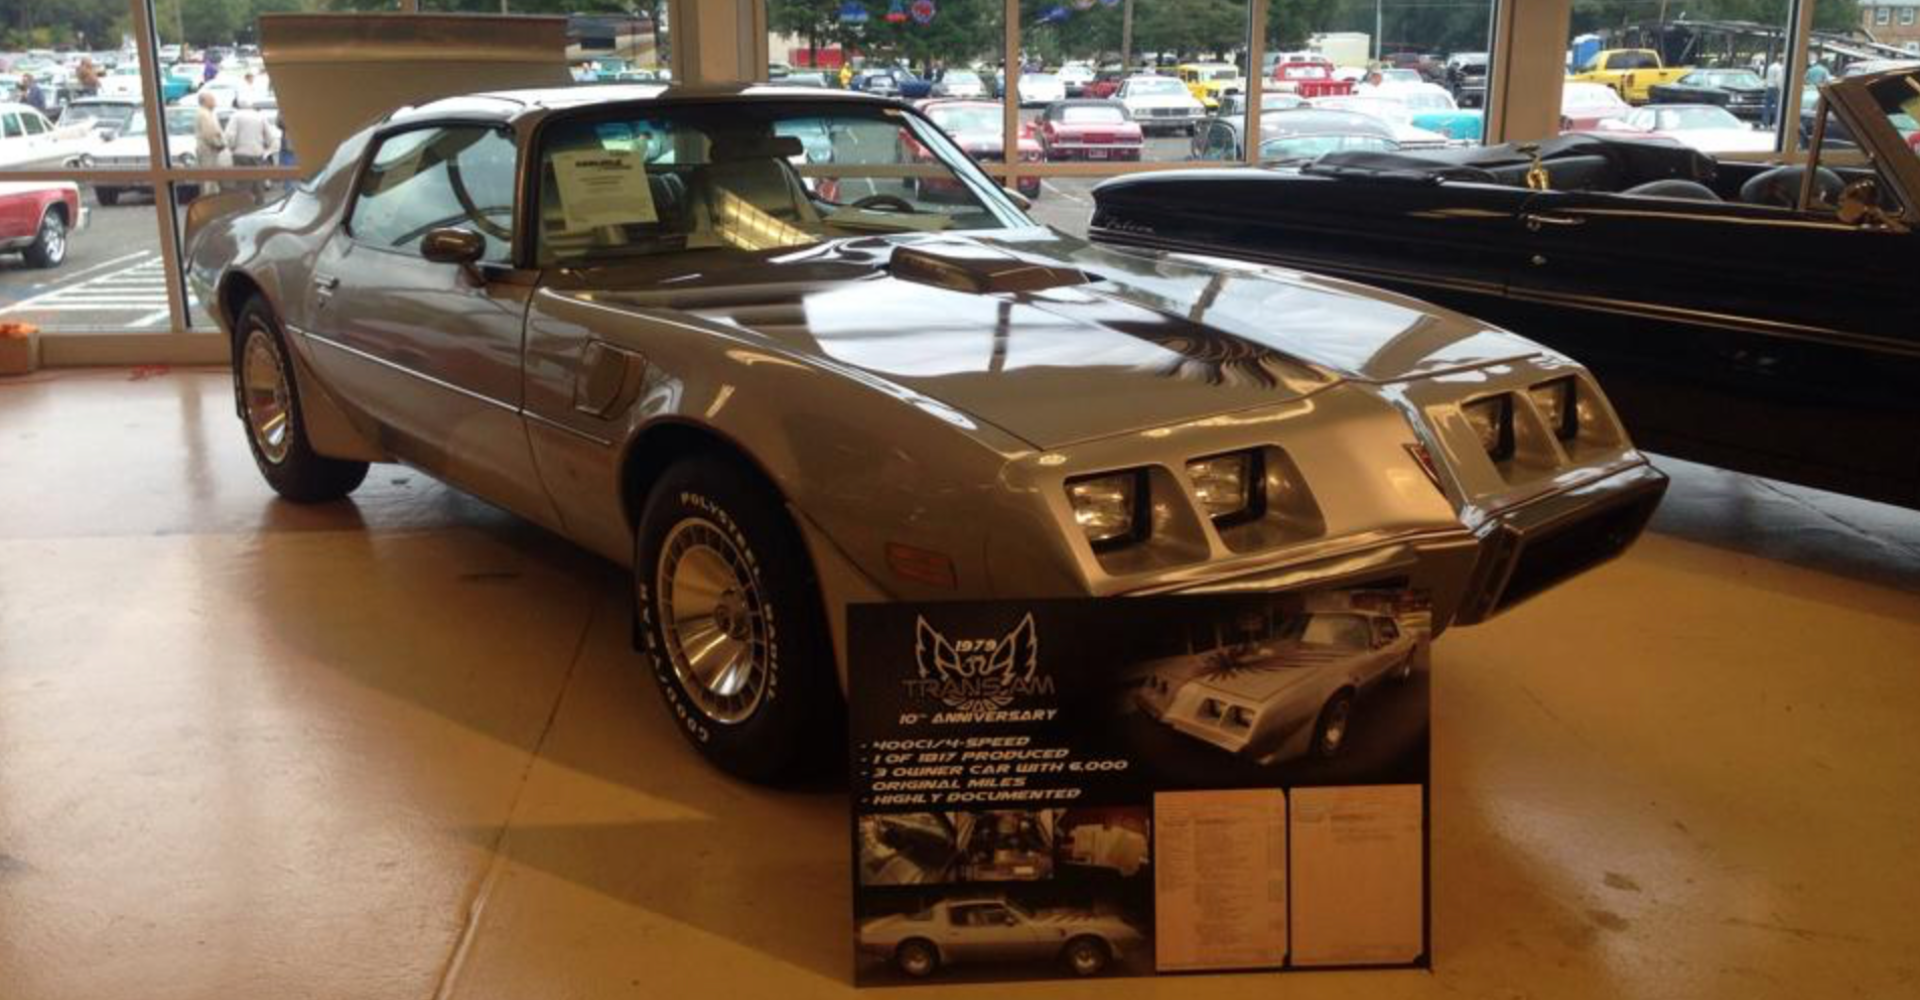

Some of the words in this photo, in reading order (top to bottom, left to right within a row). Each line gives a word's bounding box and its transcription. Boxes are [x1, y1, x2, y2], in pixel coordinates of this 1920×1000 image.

[955, 639, 998, 651] 1979
[931, 709, 1058, 724] ANNIVERSARY
[885, 752, 914, 764] OF
[918, 751, 958, 763] 1817
[961, 749, 1069, 762] PRODUCED
[872, 766, 888, 778] 3
[892, 765, 964, 777] OWNER
[969, 763, 1011, 775] CAR
[1015, 762, 1064, 773] WITH
[872, 779, 961, 791] ORIGINAL
[967, 776, 1027, 788] MILES
[872, 793, 944, 806] HIGHLY
[946, 788, 1082, 802] DOCUMENTED
